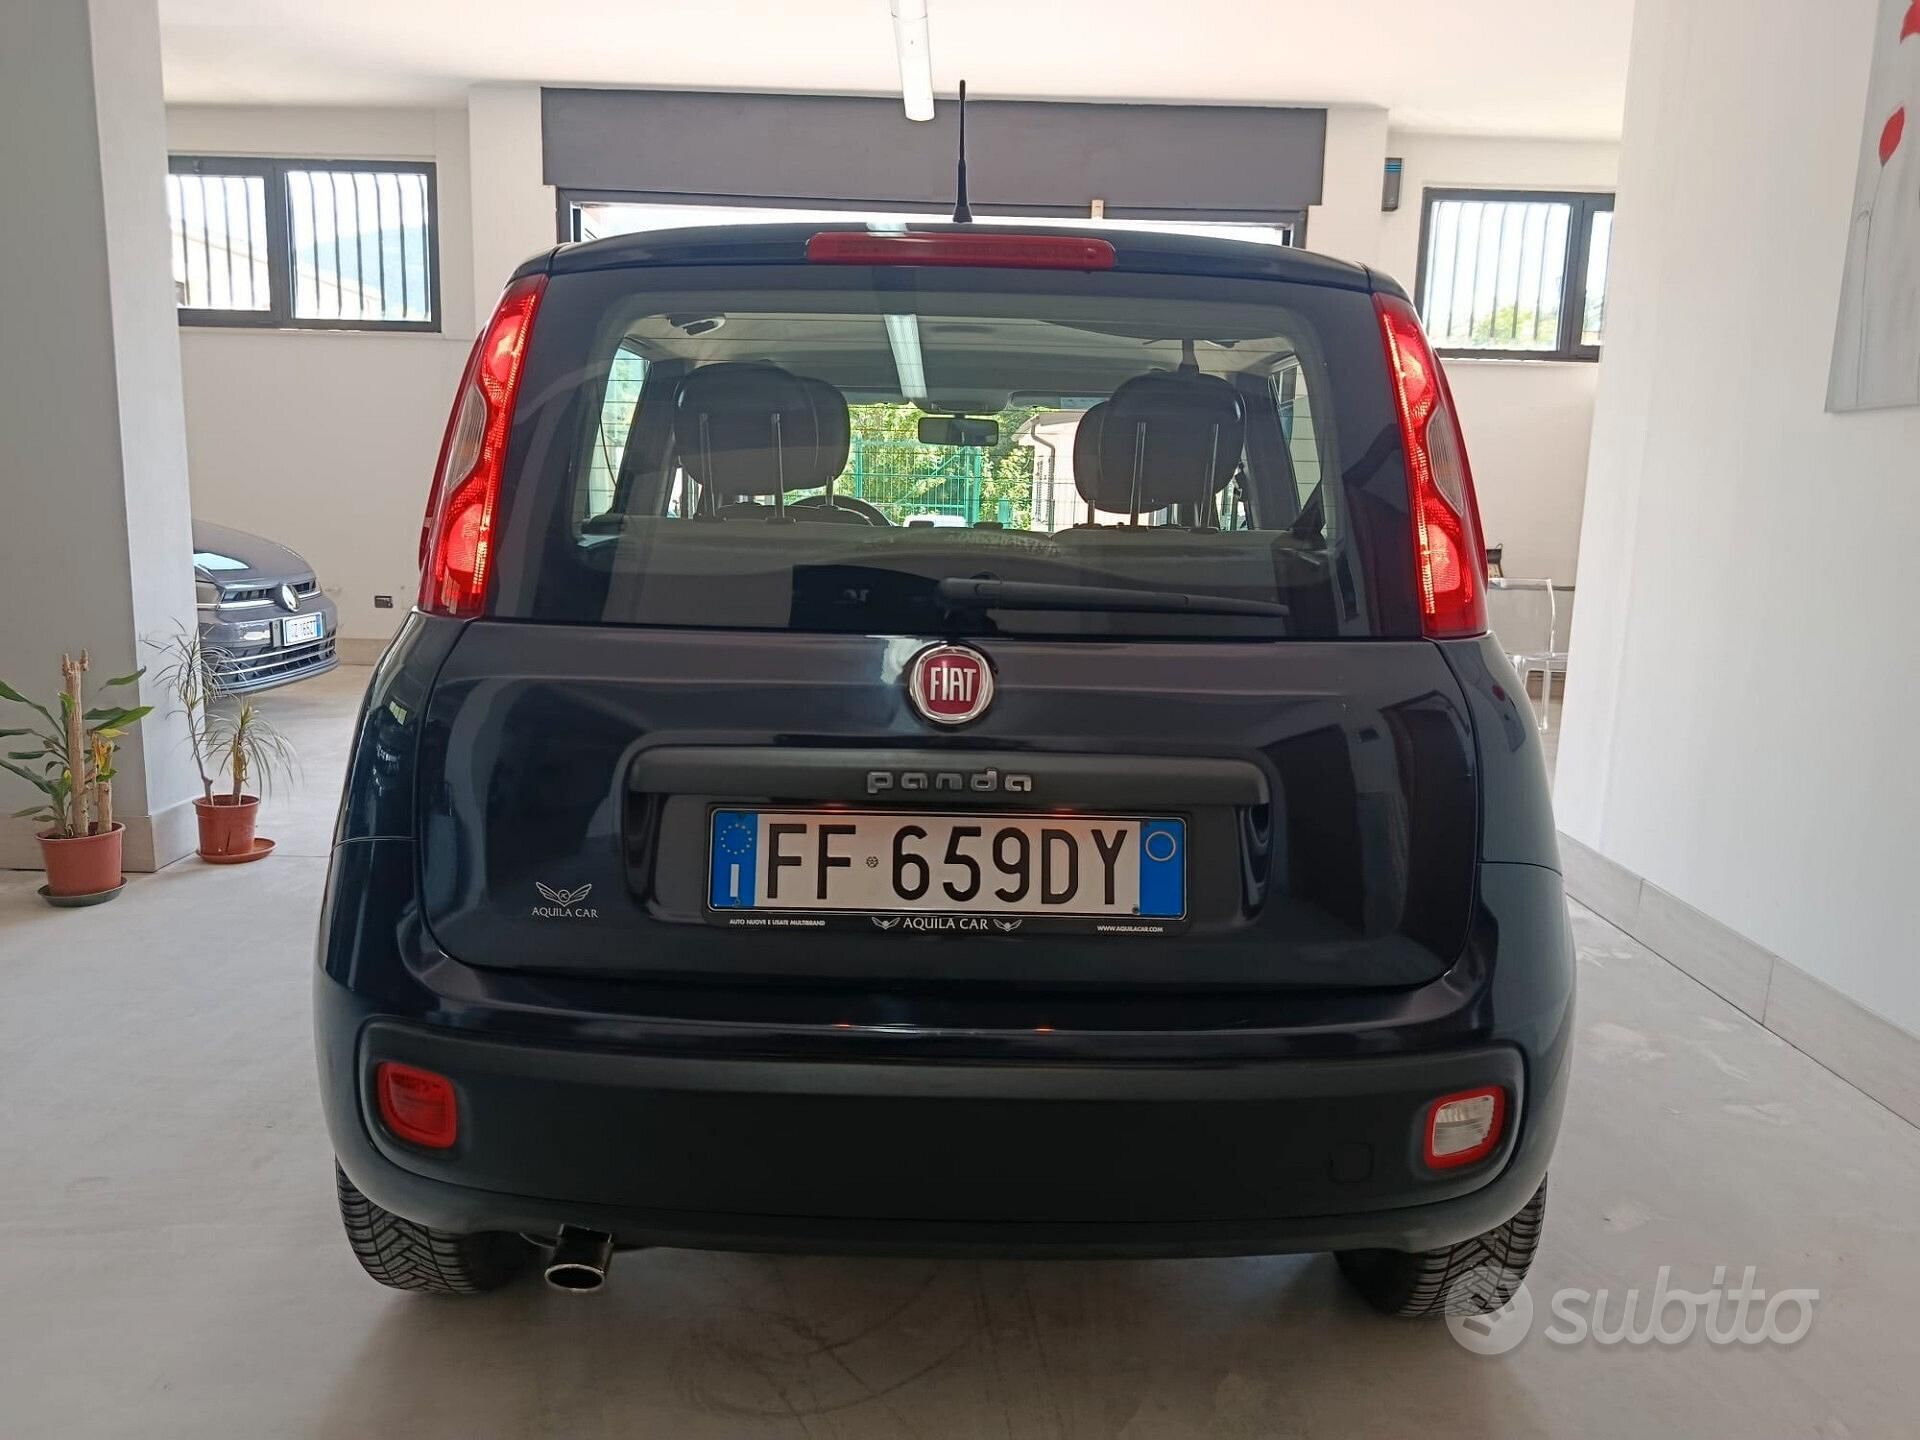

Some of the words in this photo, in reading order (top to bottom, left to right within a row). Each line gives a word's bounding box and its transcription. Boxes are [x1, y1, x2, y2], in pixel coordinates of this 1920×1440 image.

[930, 666, 977, 702] FIAT
[866, 769, 1033, 794] panda
[531, 906, 573, 918] AQUILA
[575, 908, 599, 918] CAR
[729, 918, 746, 926] AUTO
[903, 917, 956, 931] AQUILA
[959, 918, 989, 930] CAR
[1096, 924, 1164, 933] WWW.AQUILACAR.COM
